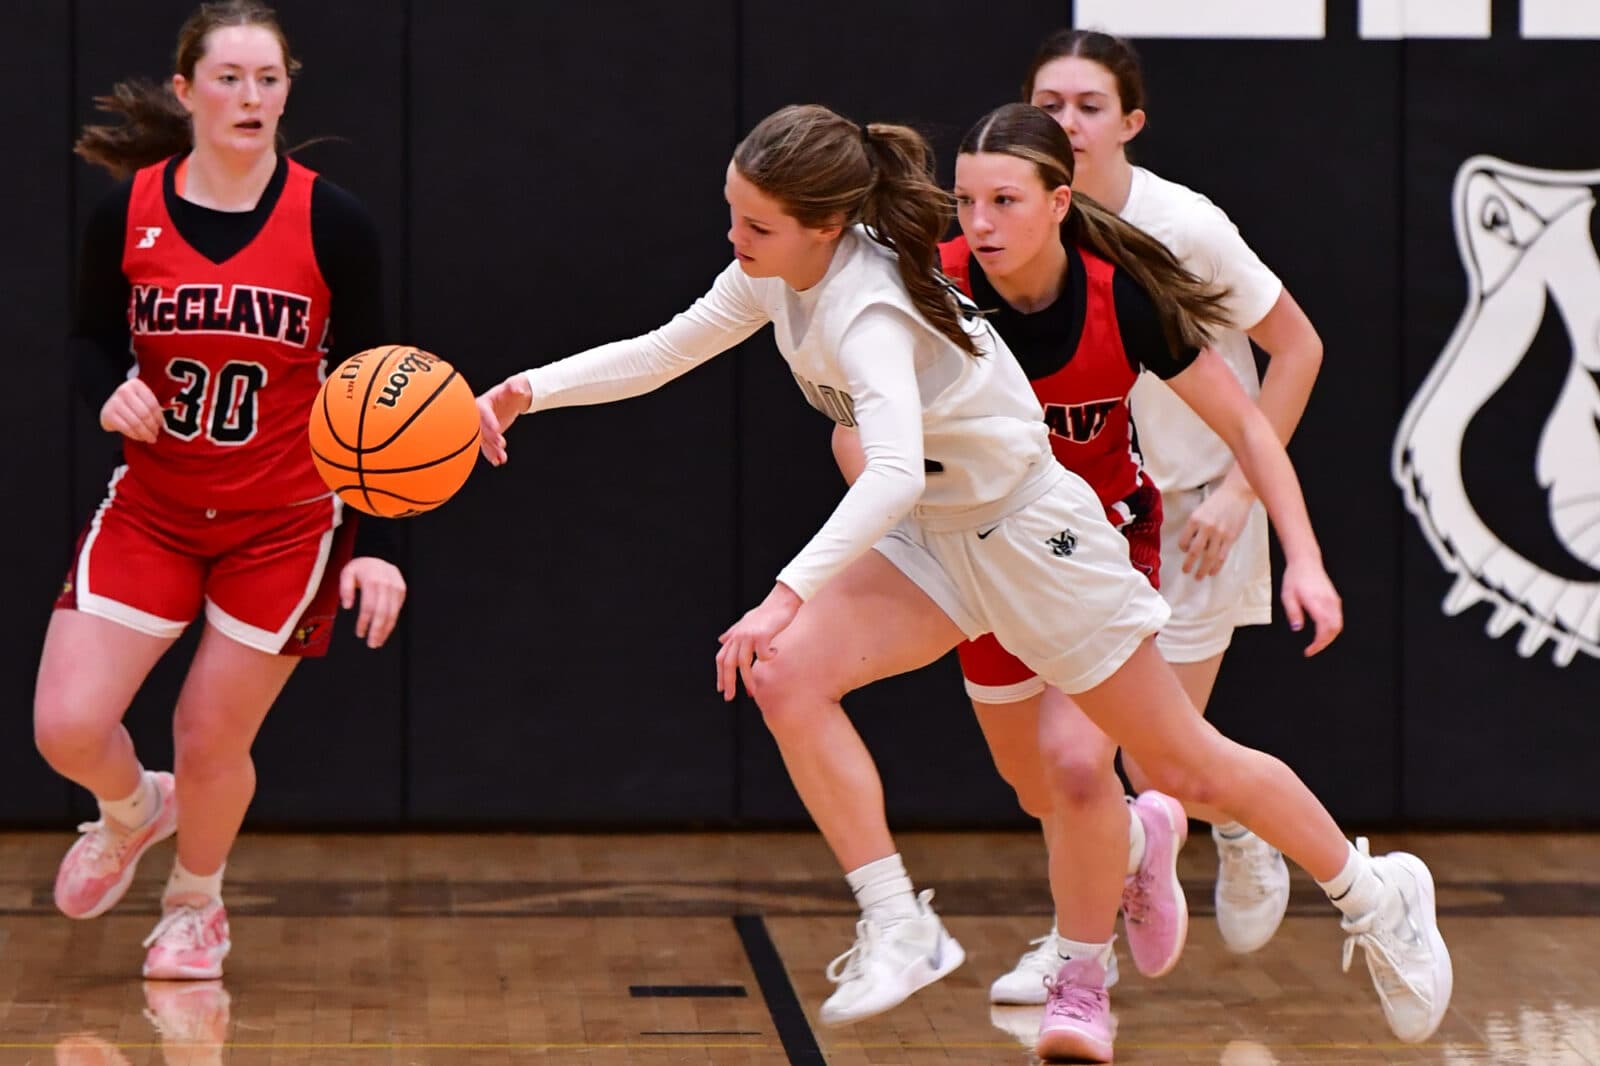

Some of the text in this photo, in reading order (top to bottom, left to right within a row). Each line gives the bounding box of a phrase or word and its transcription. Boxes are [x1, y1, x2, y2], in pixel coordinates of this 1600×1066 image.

[132, 284, 312, 348] McCLAVE
[162, 357, 268, 446] 30
[376, 349, 441, 407] ilson
